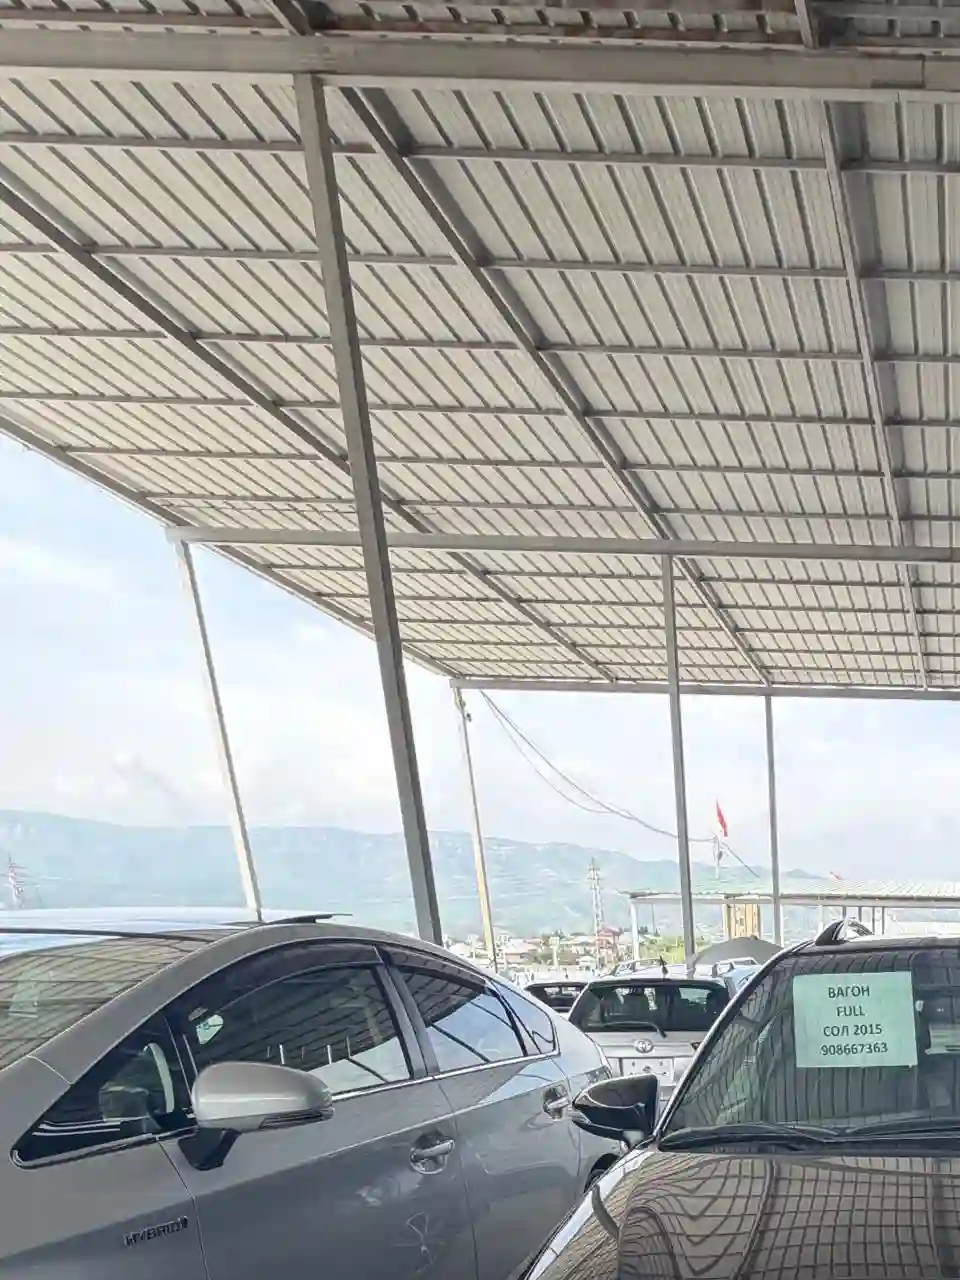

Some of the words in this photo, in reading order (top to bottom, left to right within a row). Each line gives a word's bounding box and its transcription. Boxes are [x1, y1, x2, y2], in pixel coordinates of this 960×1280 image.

[827, 985, 870, 998] ВАГОН
[836, 1005, 866, 1017] FULL
[823, 1025, 849, 1037] СОЛ
[853, 1023, 882, 1036] 2015
[821, 1042, 888, 1056] 908667363
[123, 1219, 182, 1247] HYBRID
